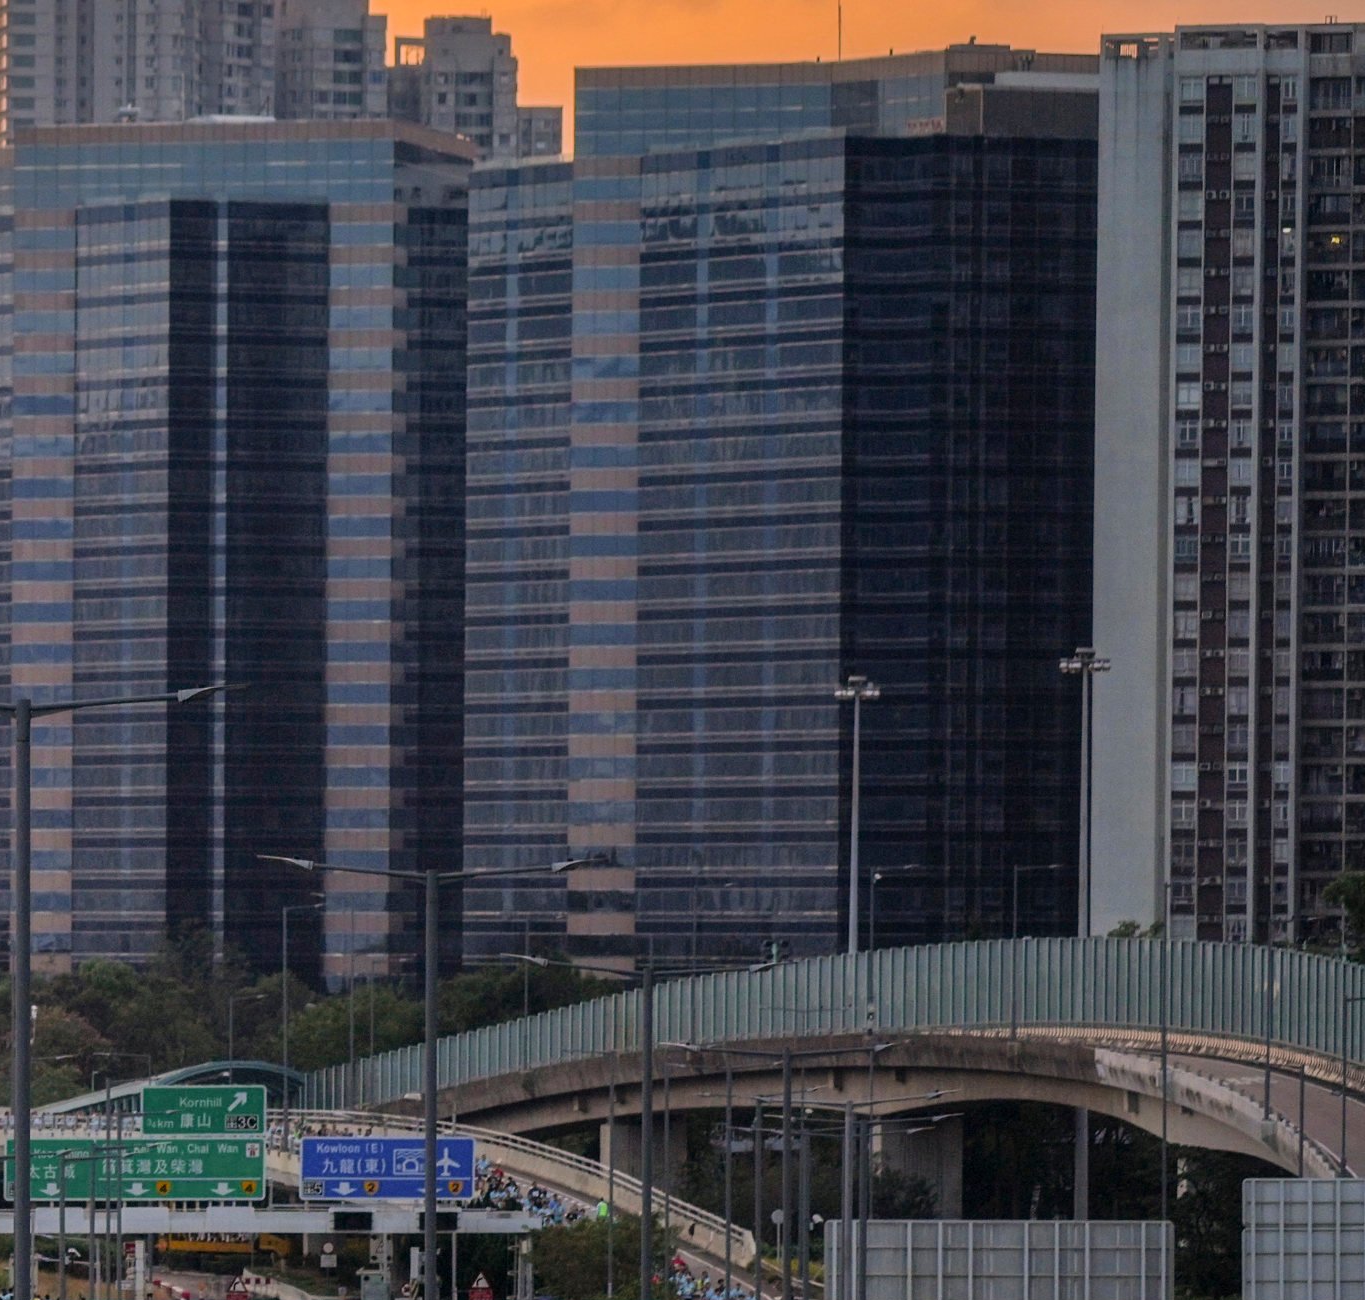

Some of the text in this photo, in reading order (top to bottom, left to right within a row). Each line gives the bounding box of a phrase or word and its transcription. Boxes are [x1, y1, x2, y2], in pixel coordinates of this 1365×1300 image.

[179, 1097, 222, 1107] Kornhill
[180, 1113, 211, 1128] 康山
[187, 1143, 209, 1153] Chai
[217, 1144, 239, 1153] Wan
[316, 1143, 384, 1154] Kowloon (E)
[322, 1158, 386, 1174] 九龍(東)
[367, 1182, 375, 1192] 2
[452, 1182, 459, 1192] 2
